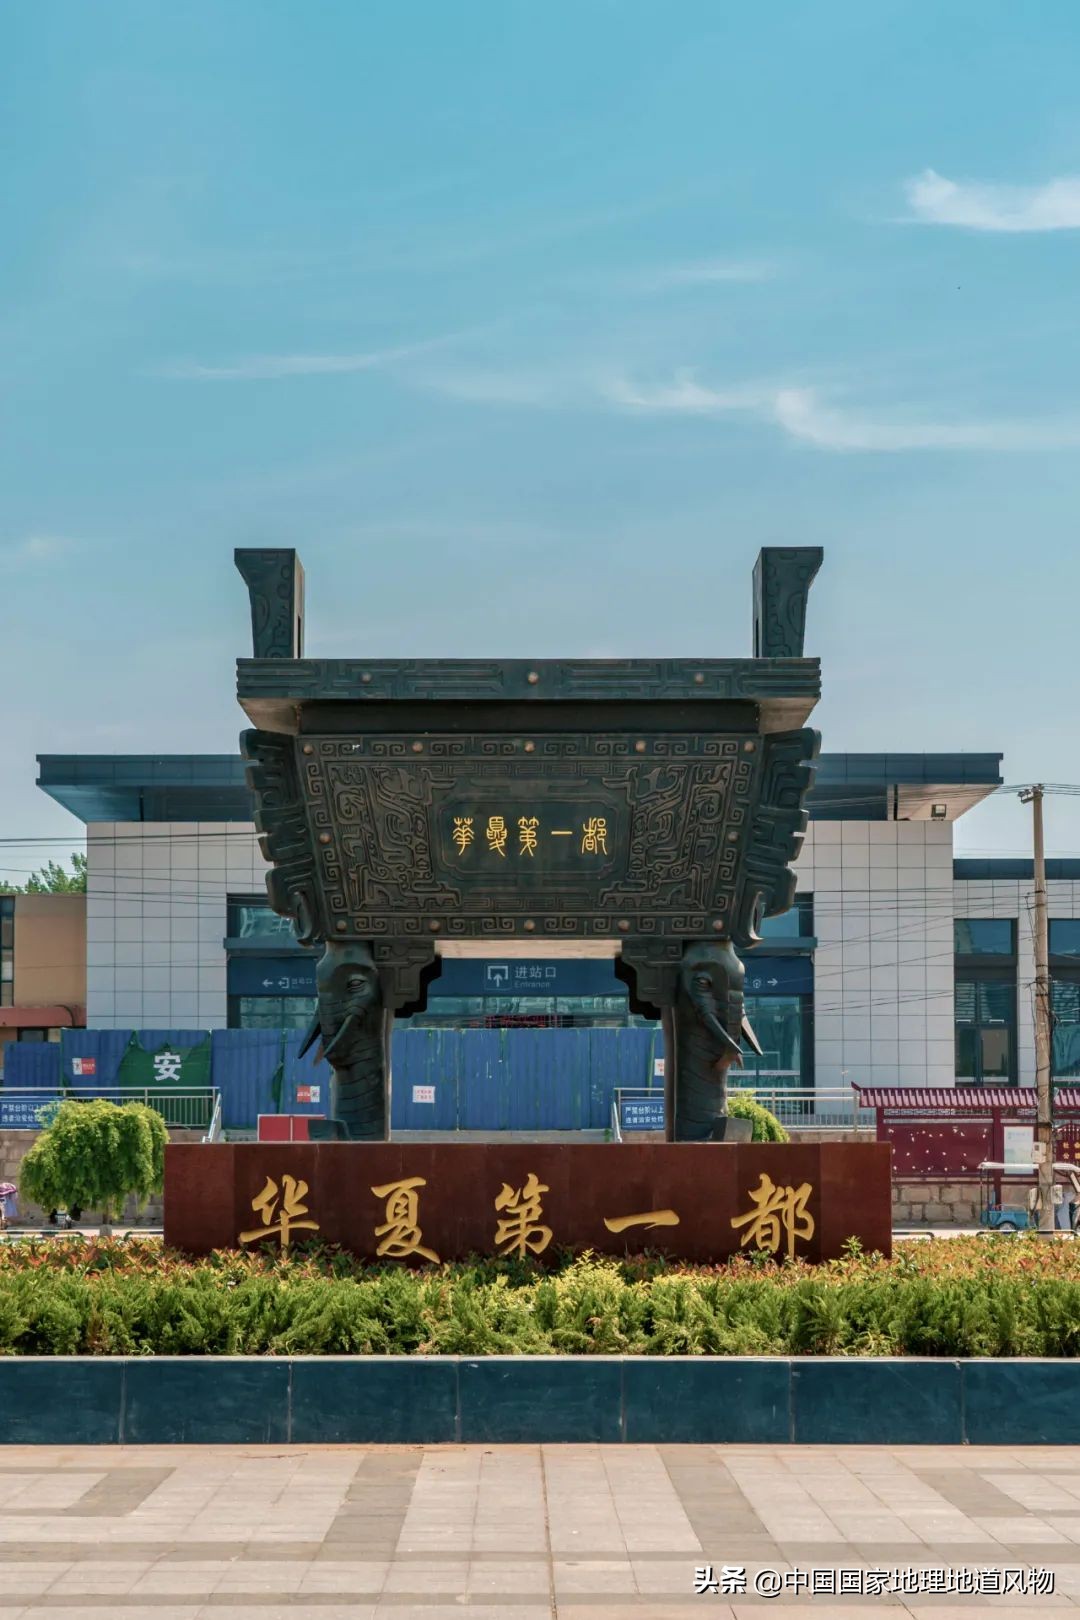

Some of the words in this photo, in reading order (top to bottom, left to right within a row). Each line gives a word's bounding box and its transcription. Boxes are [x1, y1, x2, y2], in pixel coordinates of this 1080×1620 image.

[514, 965, 557, 979] 进站口
[153, 1052, 182, 1081] 安
[238, 1173, 815, 1264] 华夏第一都
